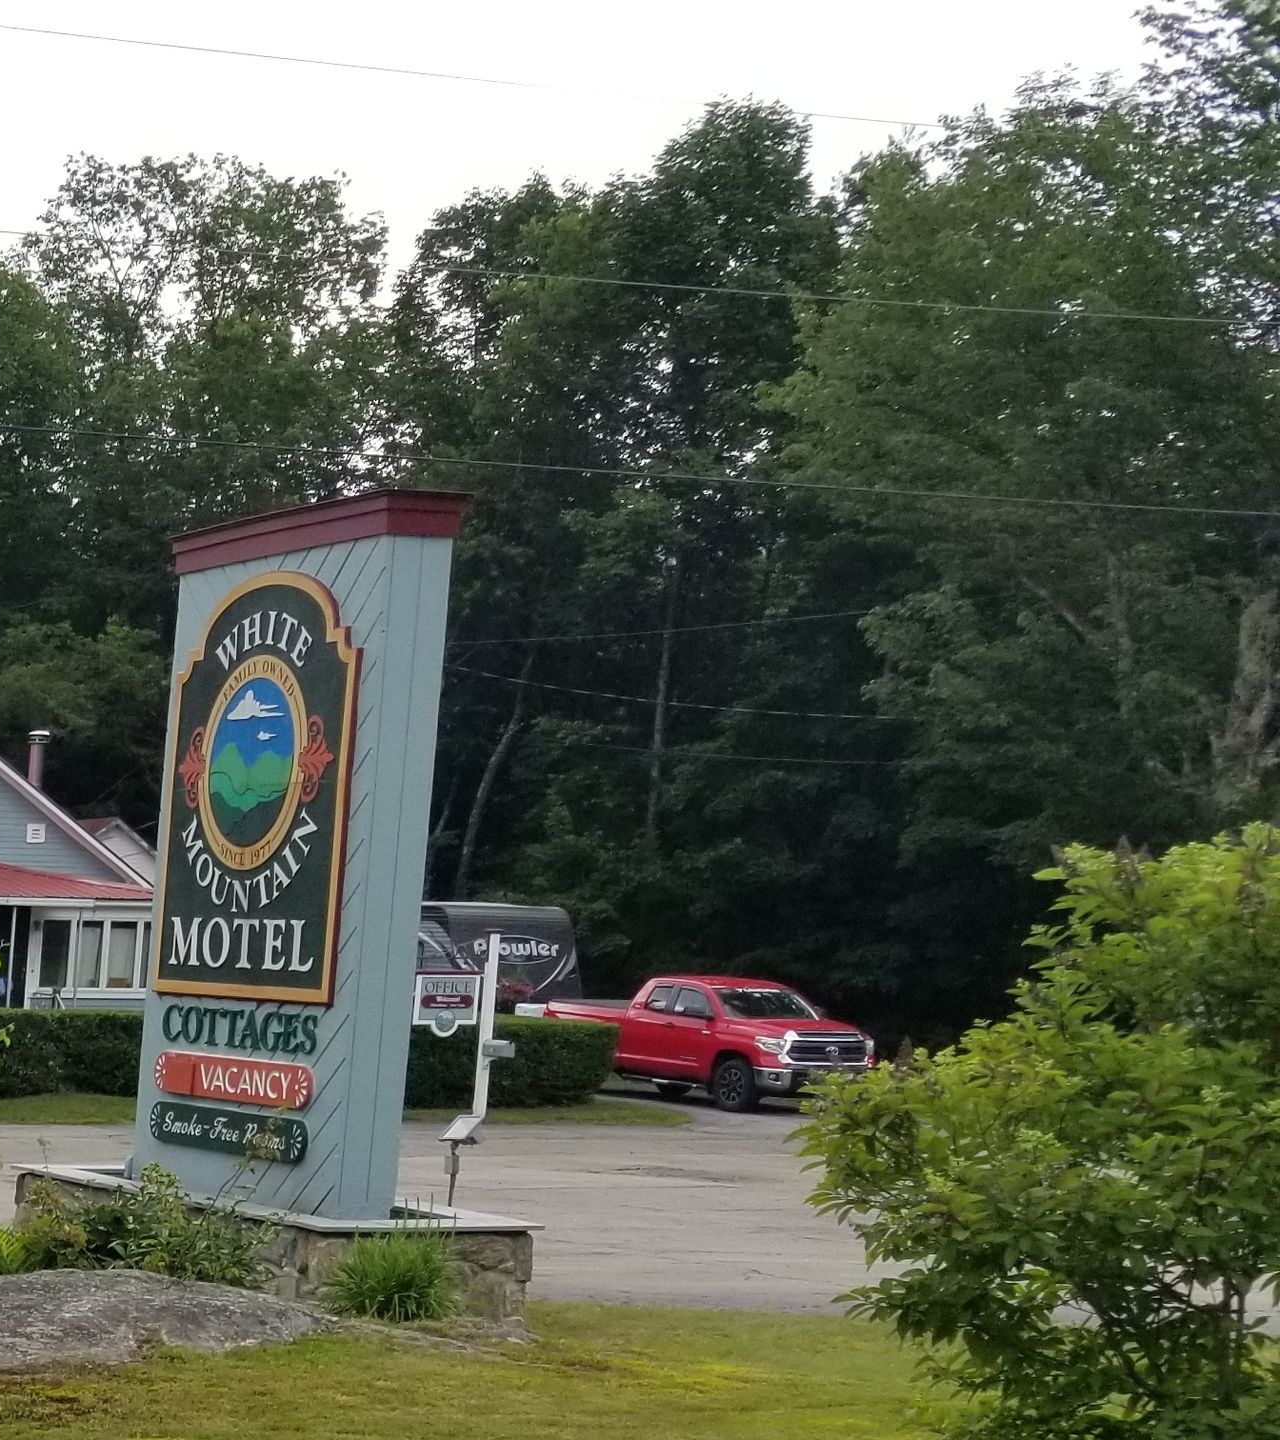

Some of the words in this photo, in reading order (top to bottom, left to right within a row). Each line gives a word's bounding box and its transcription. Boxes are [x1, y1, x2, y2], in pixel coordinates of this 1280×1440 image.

[215, 610, 313, 671] WHITE
[223, 661, 257, 701] FAMILY
[262, 660, 295, 696] OWNED
[182, 807, 318, 913] MOUNTAIN
[220, 844, 245, 866] SINCE
[251, 840, 271, 864] 1977
[168, 916, 315, 972] MOTEL
[473, 938, 560, 957] Powler
[425, 980, 471, 994] OFFICE
[162, 1004, 318, 1055] COTTAGES
[200, 1063, 291, 1100] VACANCY
[163, 1111, 239, 1142] Smoke-Free
